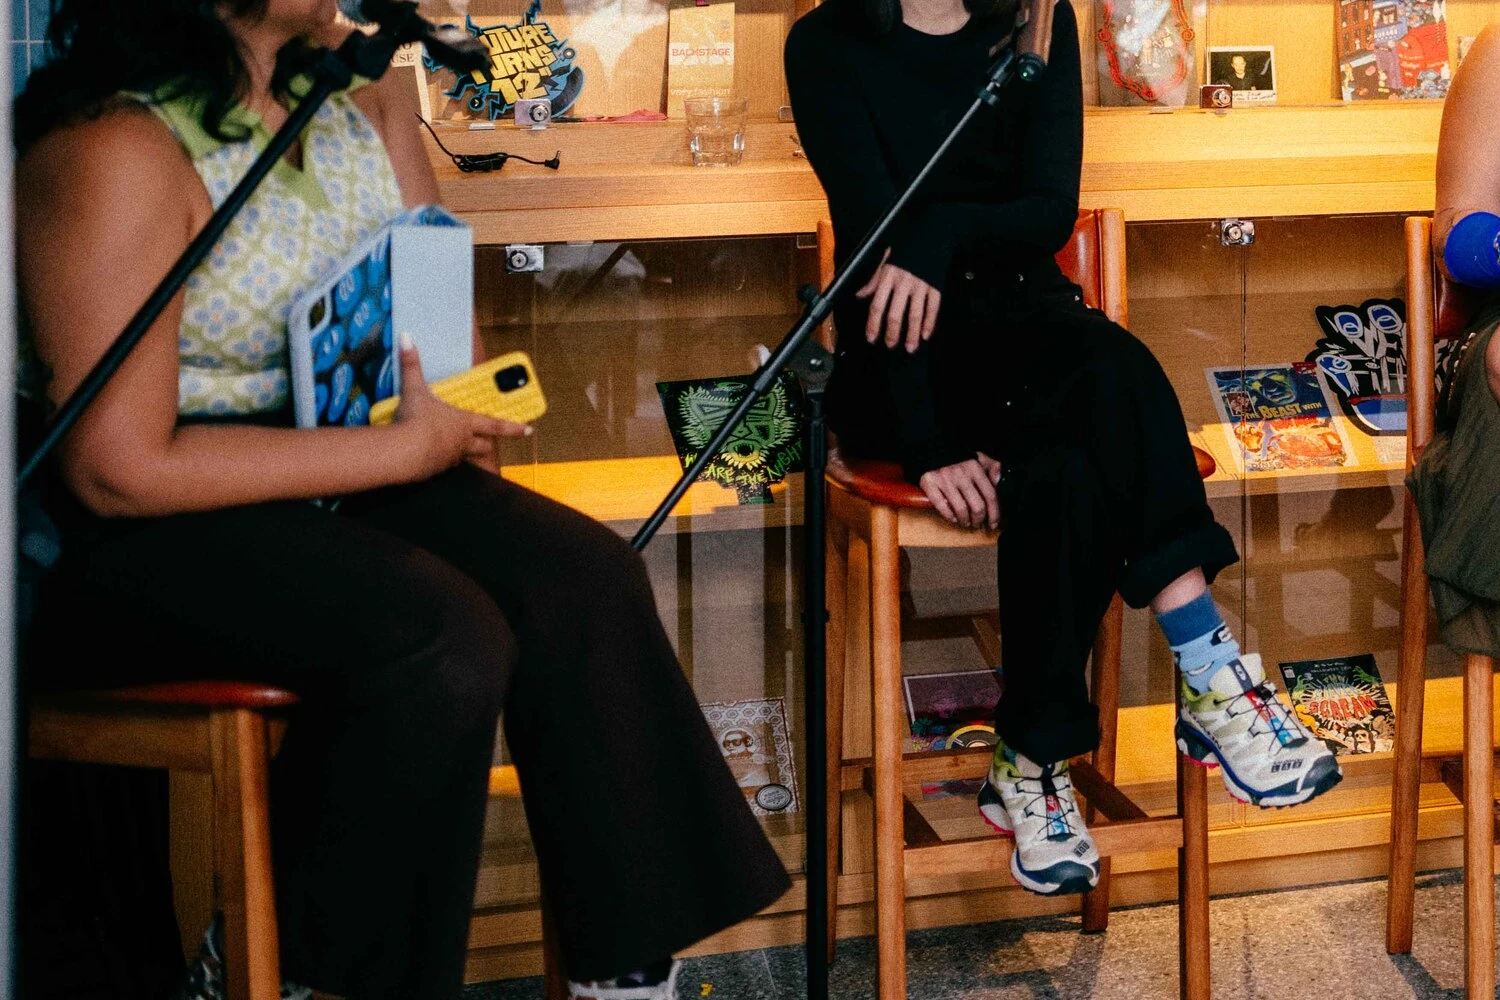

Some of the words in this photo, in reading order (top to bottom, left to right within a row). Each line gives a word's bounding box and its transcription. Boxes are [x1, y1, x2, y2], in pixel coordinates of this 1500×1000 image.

[671, 48, 731, 57] BACKSTAGE
[1258, 402, 1302, 419] BEAST
[1302, 402, 1323, 411] WITH
[705, 462, 735, 484] ARE
[736, 473, 769, 485] THE
[1309, 694, 1378, 721] SCREAM
